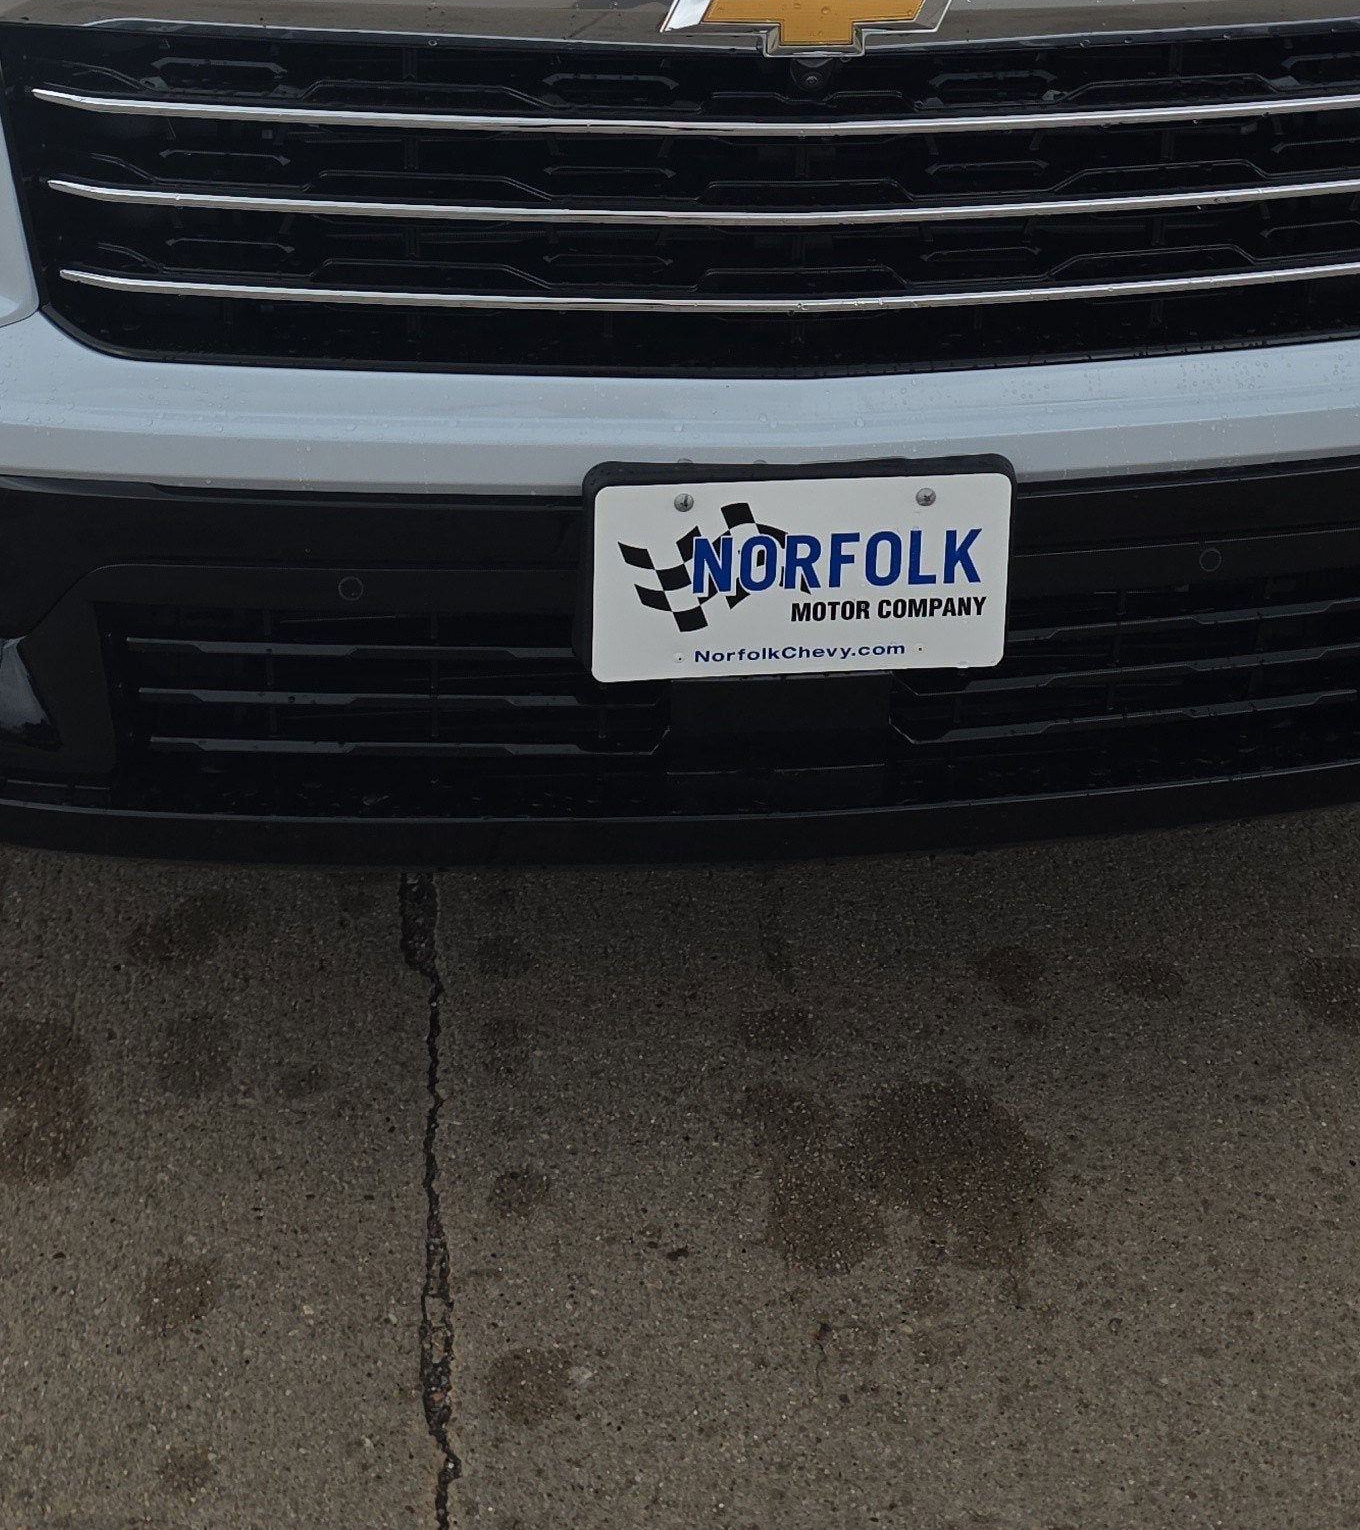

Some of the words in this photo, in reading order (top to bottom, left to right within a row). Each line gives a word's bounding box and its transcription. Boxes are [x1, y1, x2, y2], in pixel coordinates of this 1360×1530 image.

[692, 528, 983, 594] NORFOLK
[790, 600, 870, 622] MOTOR
[877, 596, 987, 619] COMPANY
[694, 643, 906, 663] NorfolkChevy.com
